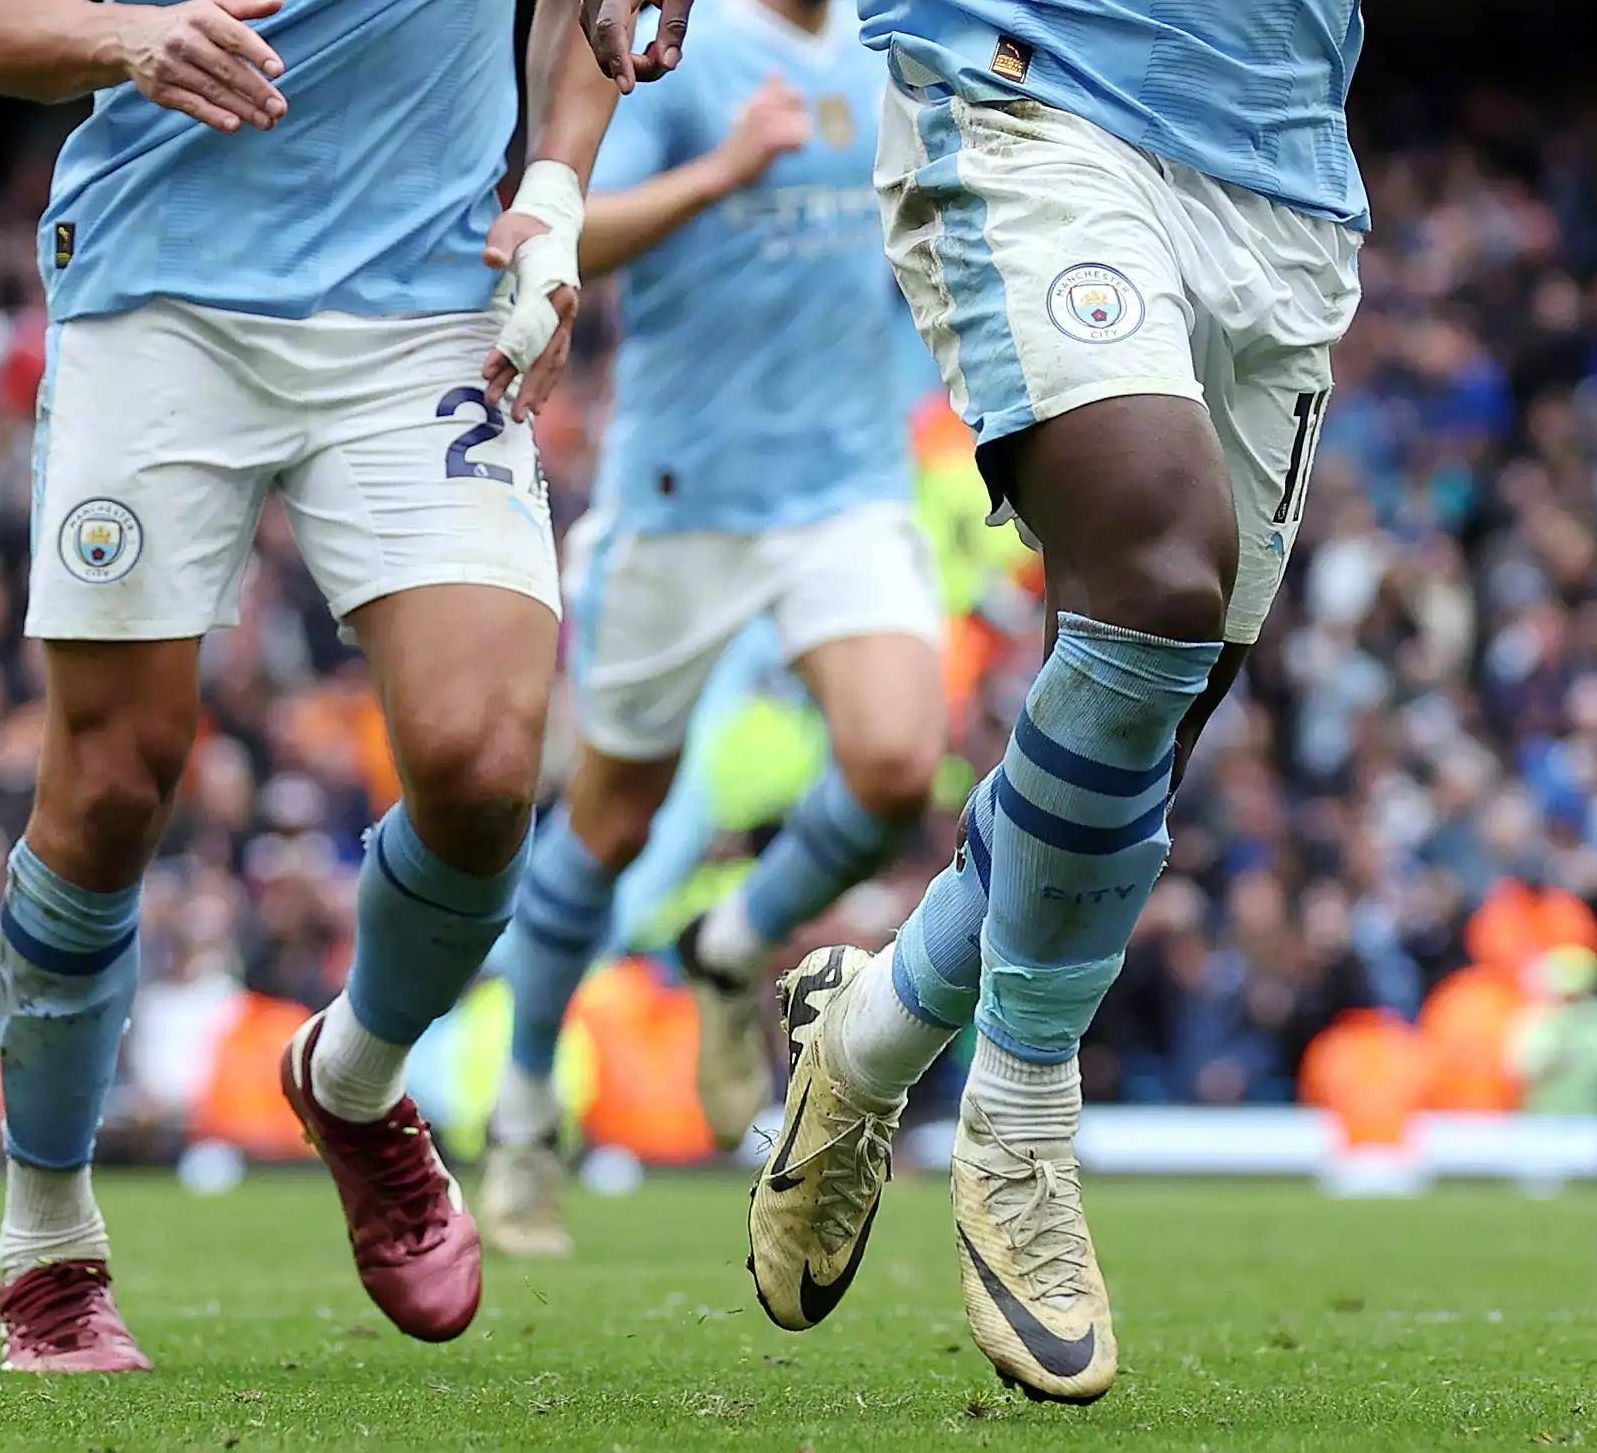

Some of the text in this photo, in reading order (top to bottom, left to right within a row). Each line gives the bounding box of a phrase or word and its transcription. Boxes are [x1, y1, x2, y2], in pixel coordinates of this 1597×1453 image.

[1056, 270, 1131, 298] MANCHESTER
[1090, 329, 1118, 339] CITY
[70, 502, 137, 531] MANCHESTER
